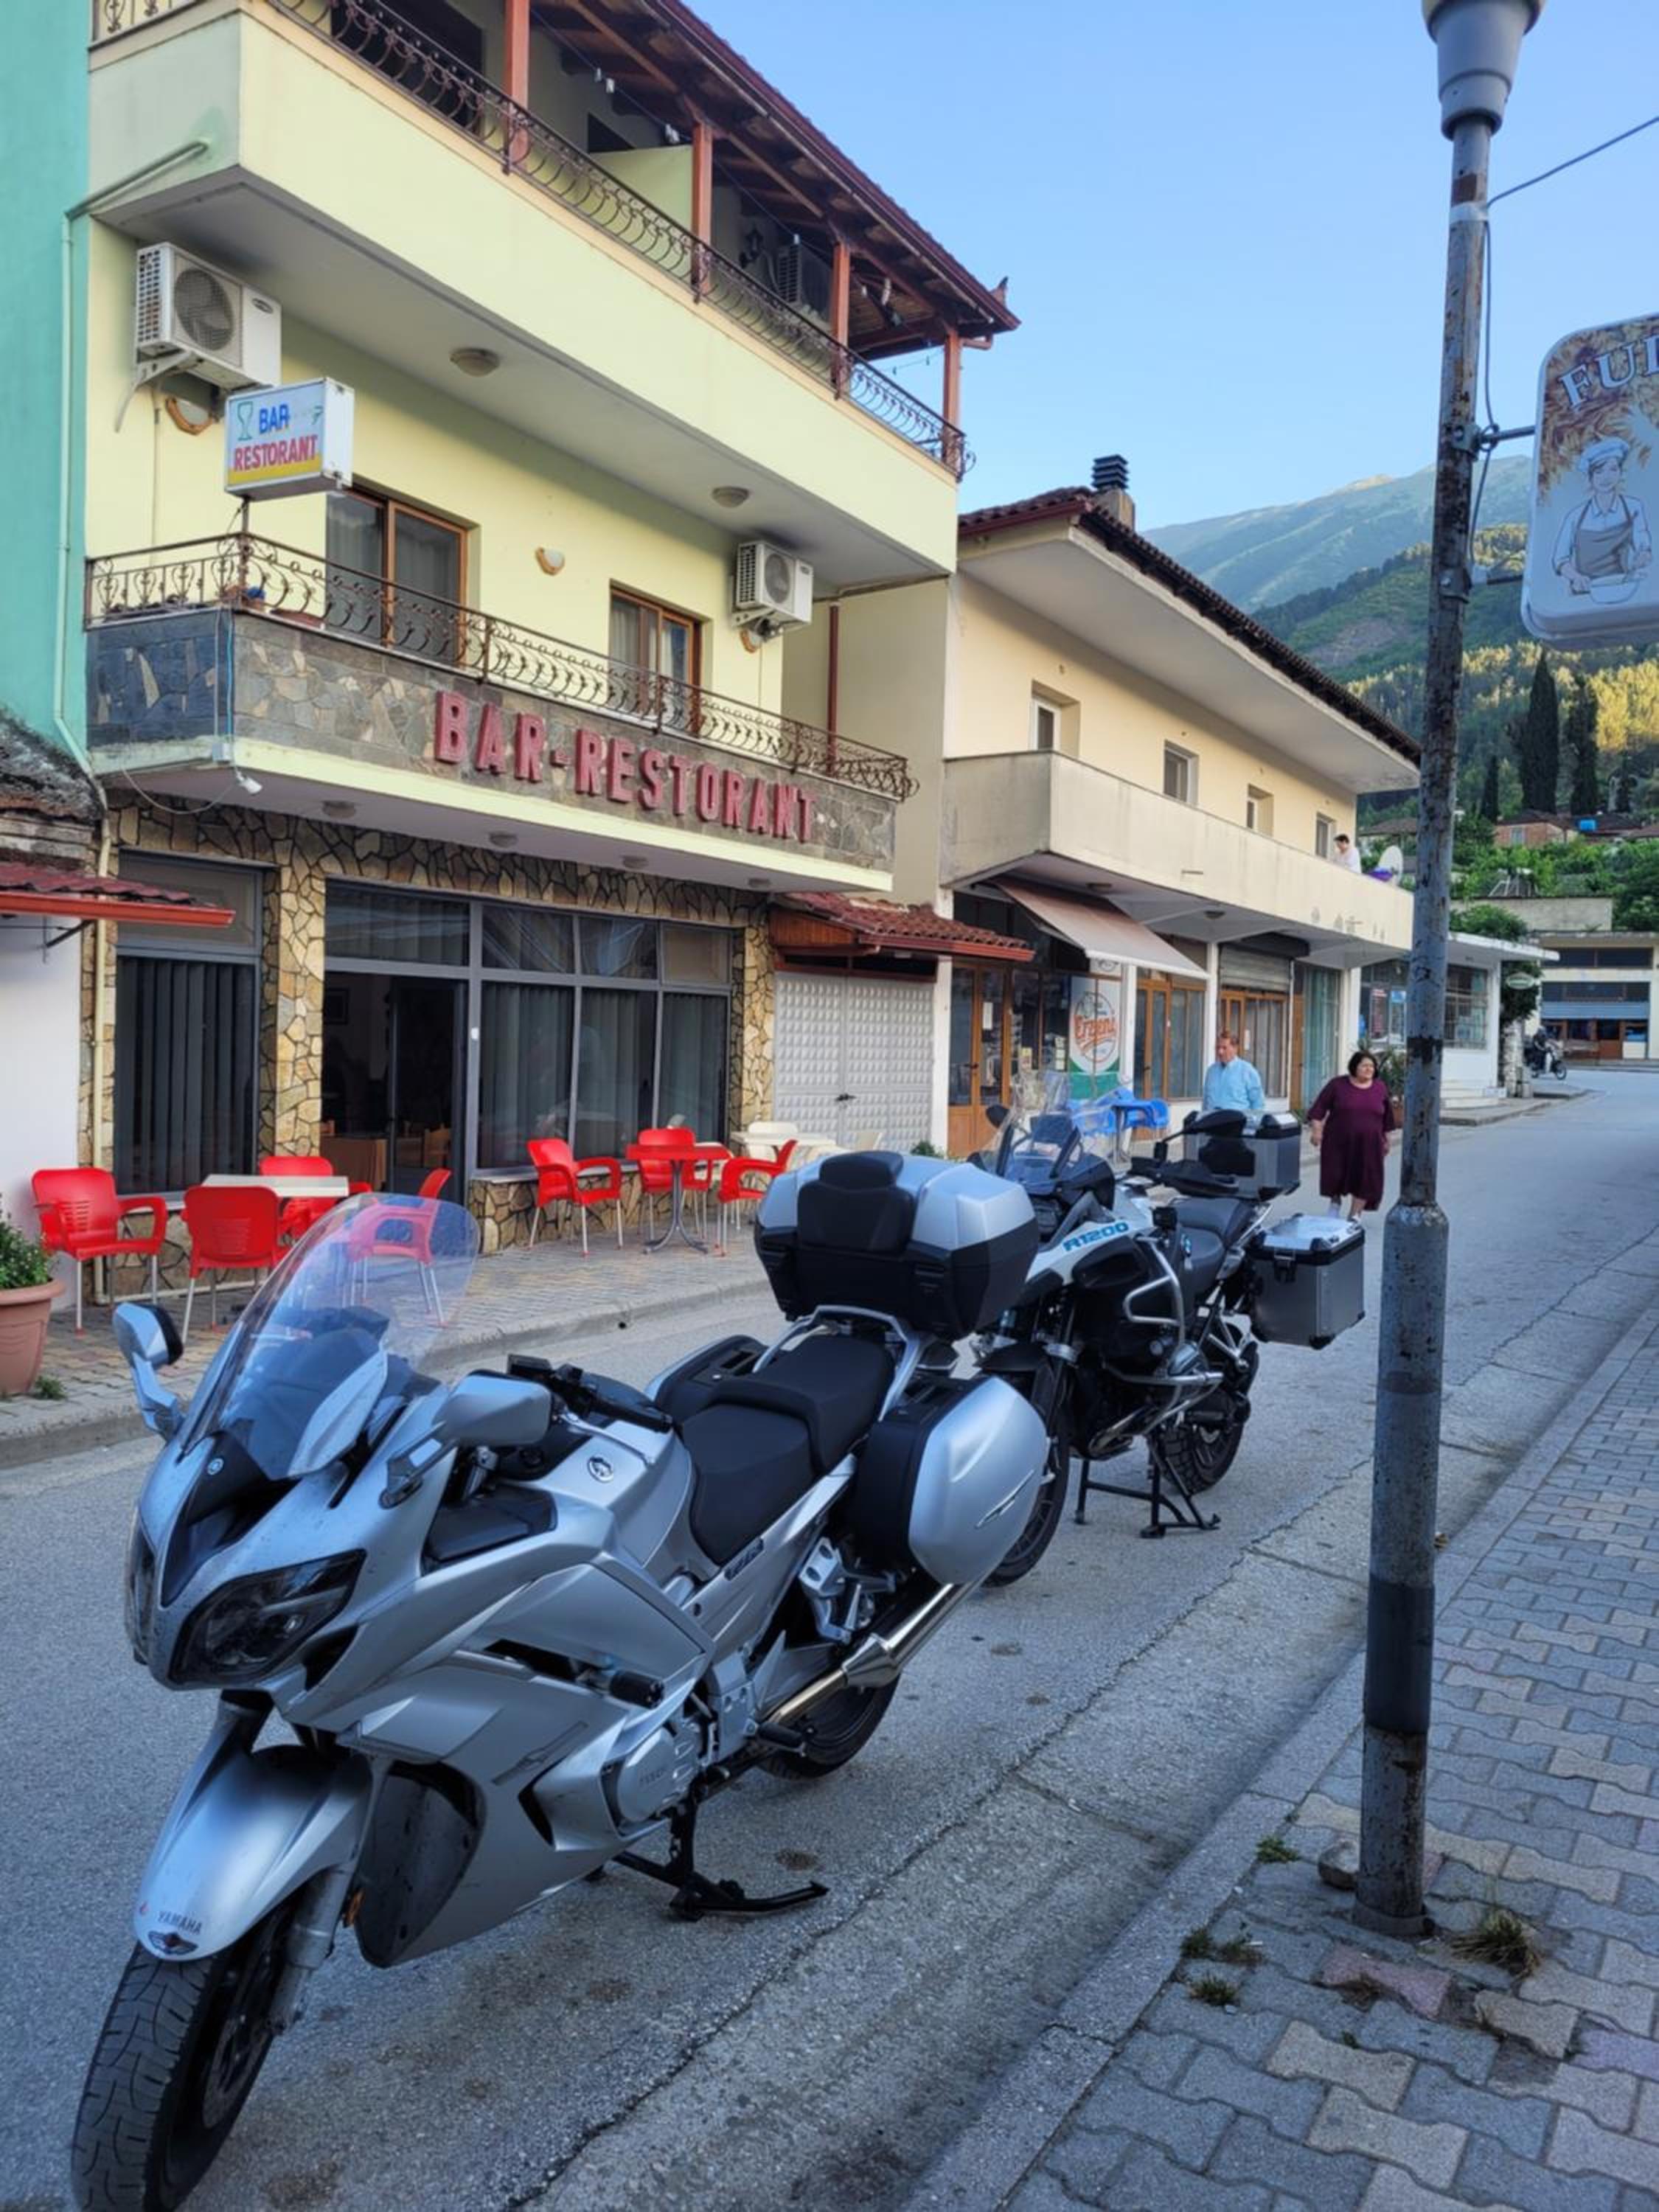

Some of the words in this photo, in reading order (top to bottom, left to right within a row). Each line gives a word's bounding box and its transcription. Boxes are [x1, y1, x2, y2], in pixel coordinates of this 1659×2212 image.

[259, 404, 290, 434] BAR
[234, 435, 319, 471] RESTORANT
[1063, 1222, 1130, 1251] R1200
[158, 1910, 202, 1935] YAMAHA
